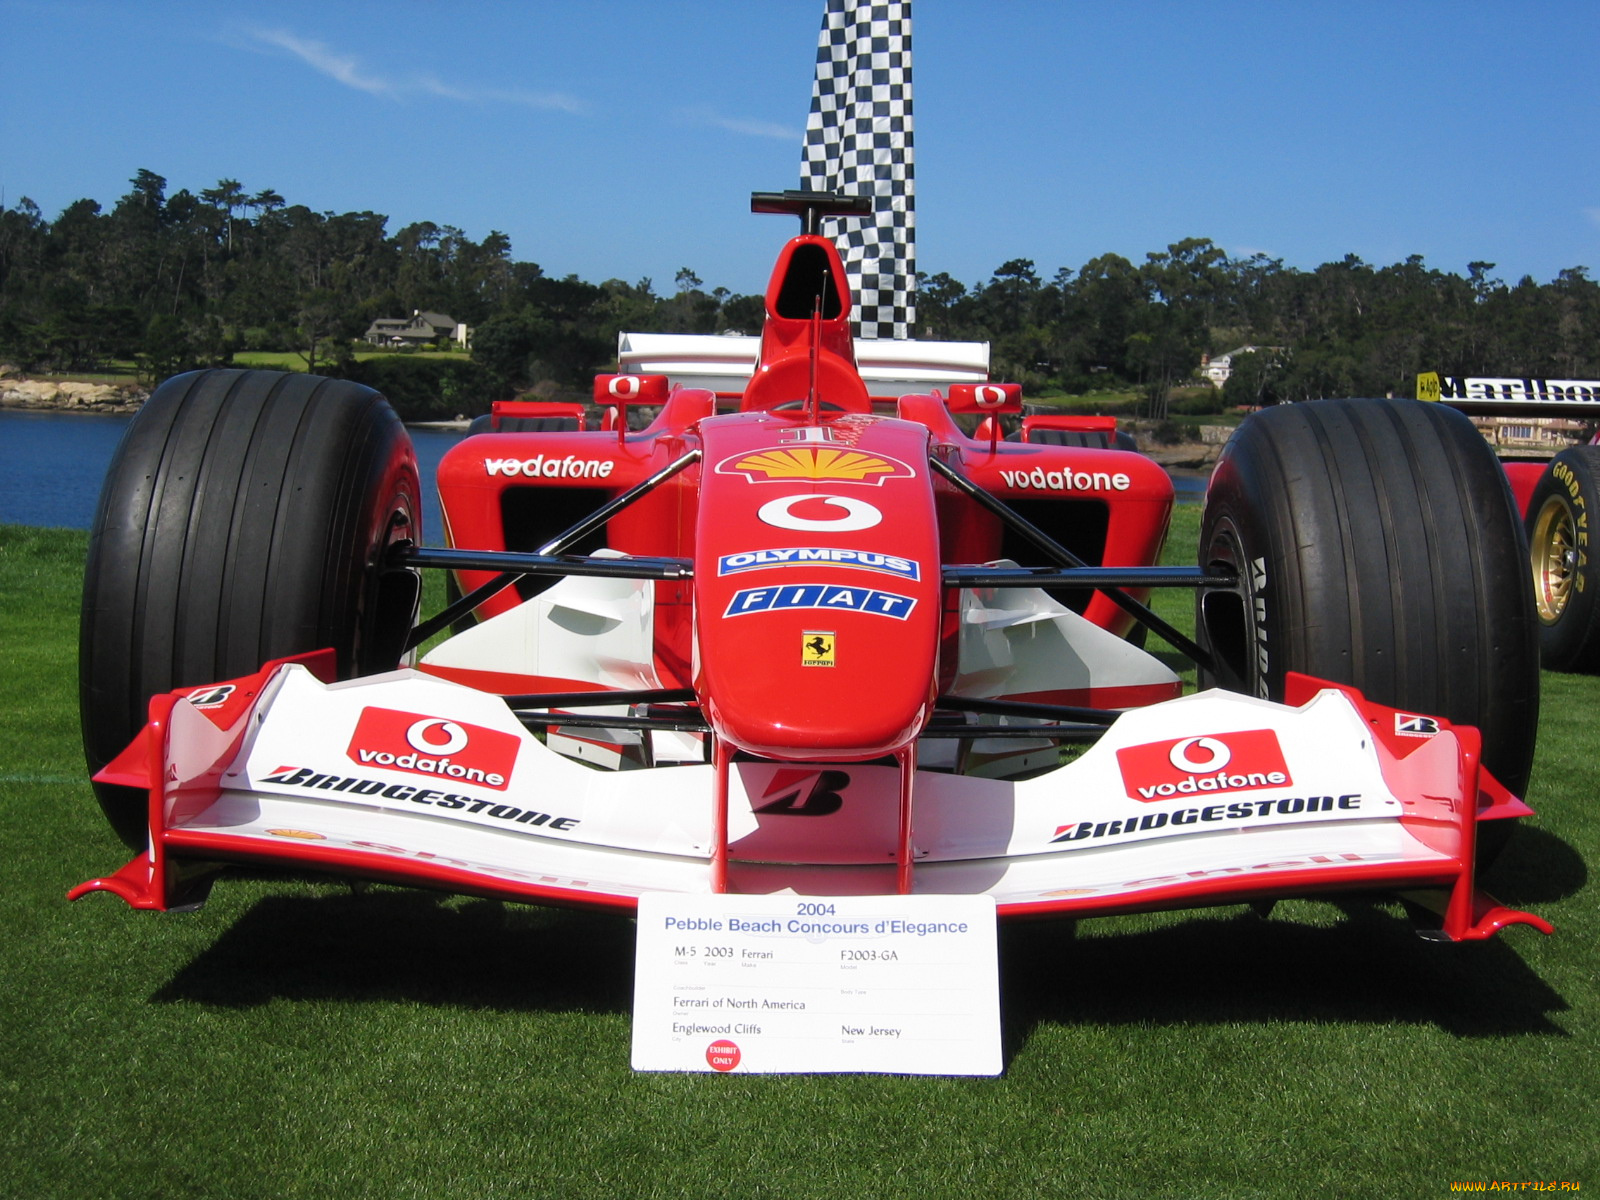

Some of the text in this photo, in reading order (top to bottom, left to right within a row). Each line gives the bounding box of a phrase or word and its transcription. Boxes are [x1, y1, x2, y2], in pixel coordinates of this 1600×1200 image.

[485, 455, 614, 478] vodafone
[999, 466, 1131, 492] vodafone
[726, 548, 912, 572] OLYMPUS
[741, 588, 903, 612] FIAT
[358, 748, 506, 787] vodafone
[1138, 769, 1287, 799] vodafone
[256, 765, 581, 832] BRIDGESTONE
[1049, 794, 1362, 844] BRIDGESTONE
[796, 903, 836, 916] 2004
[665, 917, 968, 936] Pebble Beach Concours d'Elegance
[675, 946, 774, 959] M-5 2003 Ferrari
[840, 950, 898, 961] F2003-GA
[673, 996, 806, 1010] Ferrari of North America
[672, 1022, 762, 1036] Englewood Cliffs
[841, 1025, 902, 1039] New Jersey
[709, 1046, 738, 1055] EXHIBIT
[712, 1056, 734, 1065] ONLY
